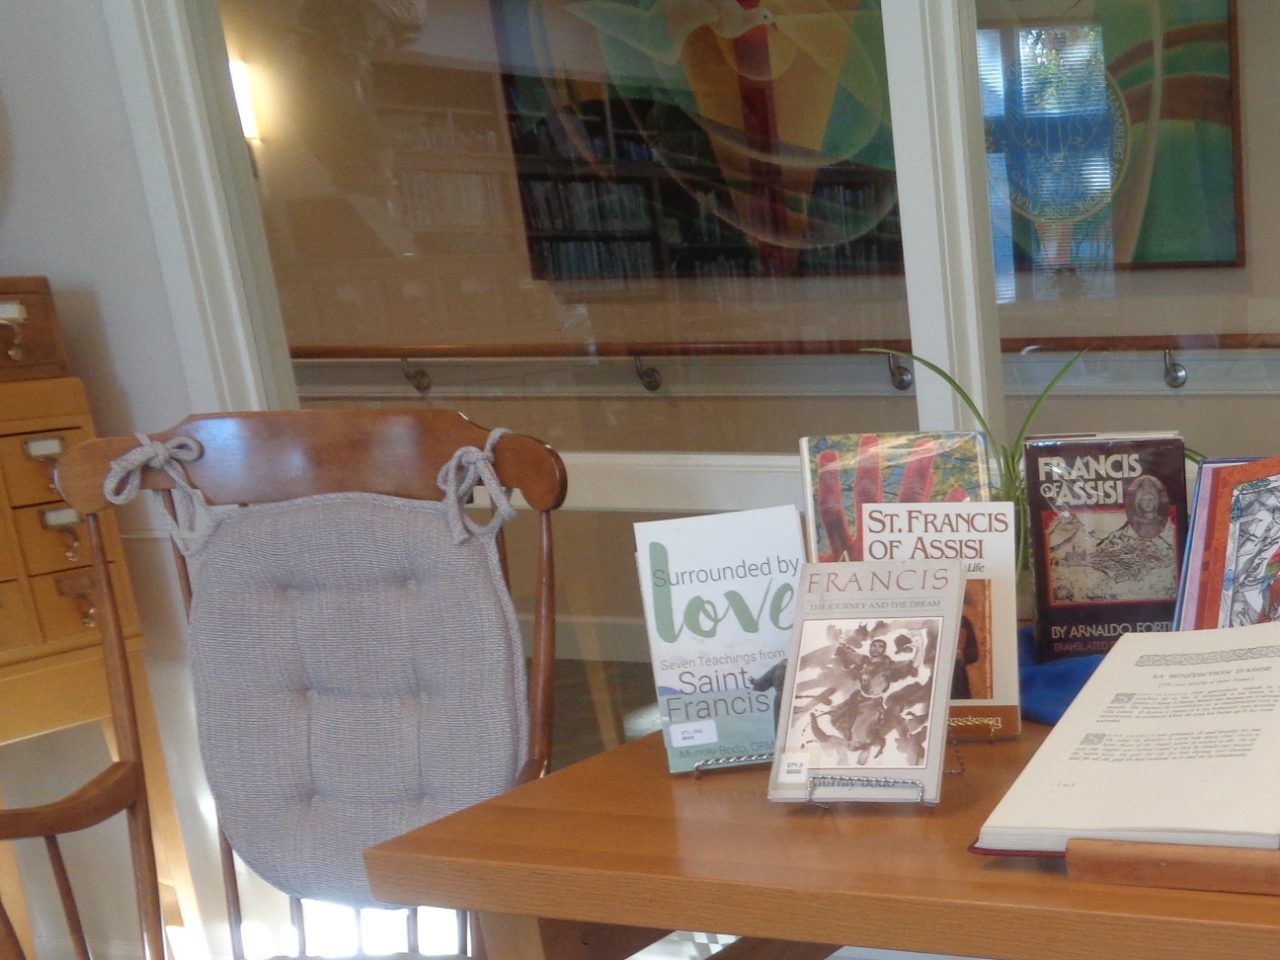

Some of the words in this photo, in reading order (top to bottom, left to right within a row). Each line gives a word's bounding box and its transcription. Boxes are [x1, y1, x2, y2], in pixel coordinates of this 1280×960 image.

[1038, 453, 1142, 480] FRANCIS
[1040, 482, 1061, 498] OF
[1055, 480, 1124, 505] ASSISI
[868, 510, 902, 534] ST.
[907, 510, 1009, 533] FRANCIS
[869, 540, 902, 560] OF
[910, 537, 984, 560] ASSISI
[653, 557, 772, 588] Surrounded
[777, 555, 799, 577] by
[967, 562, 985, 573] Life
[649, 541, 794, 643] love
[807, 568, 950, 594] FRANCIS
[809, 602, 826, 611] THE
[827, 601, 867, 611] JOURNEY
[868, 600, 891, 610] AND
[892, 600, 908, 610] THE
[909, 599, 941, 609] DREAM
[1051, 626, 1067, 639] BY
[1069, 623, 1132, 639] ARNALDO
[1136, 621, 1173, 633] FORTI
[661, 657, 697, 671] Seven
[699, 652, 757, 668] Teachings
[759, 649, 785, 661] from
[679, 667, 751, 695] Saint
[667, 692, 770, 721] Francis
